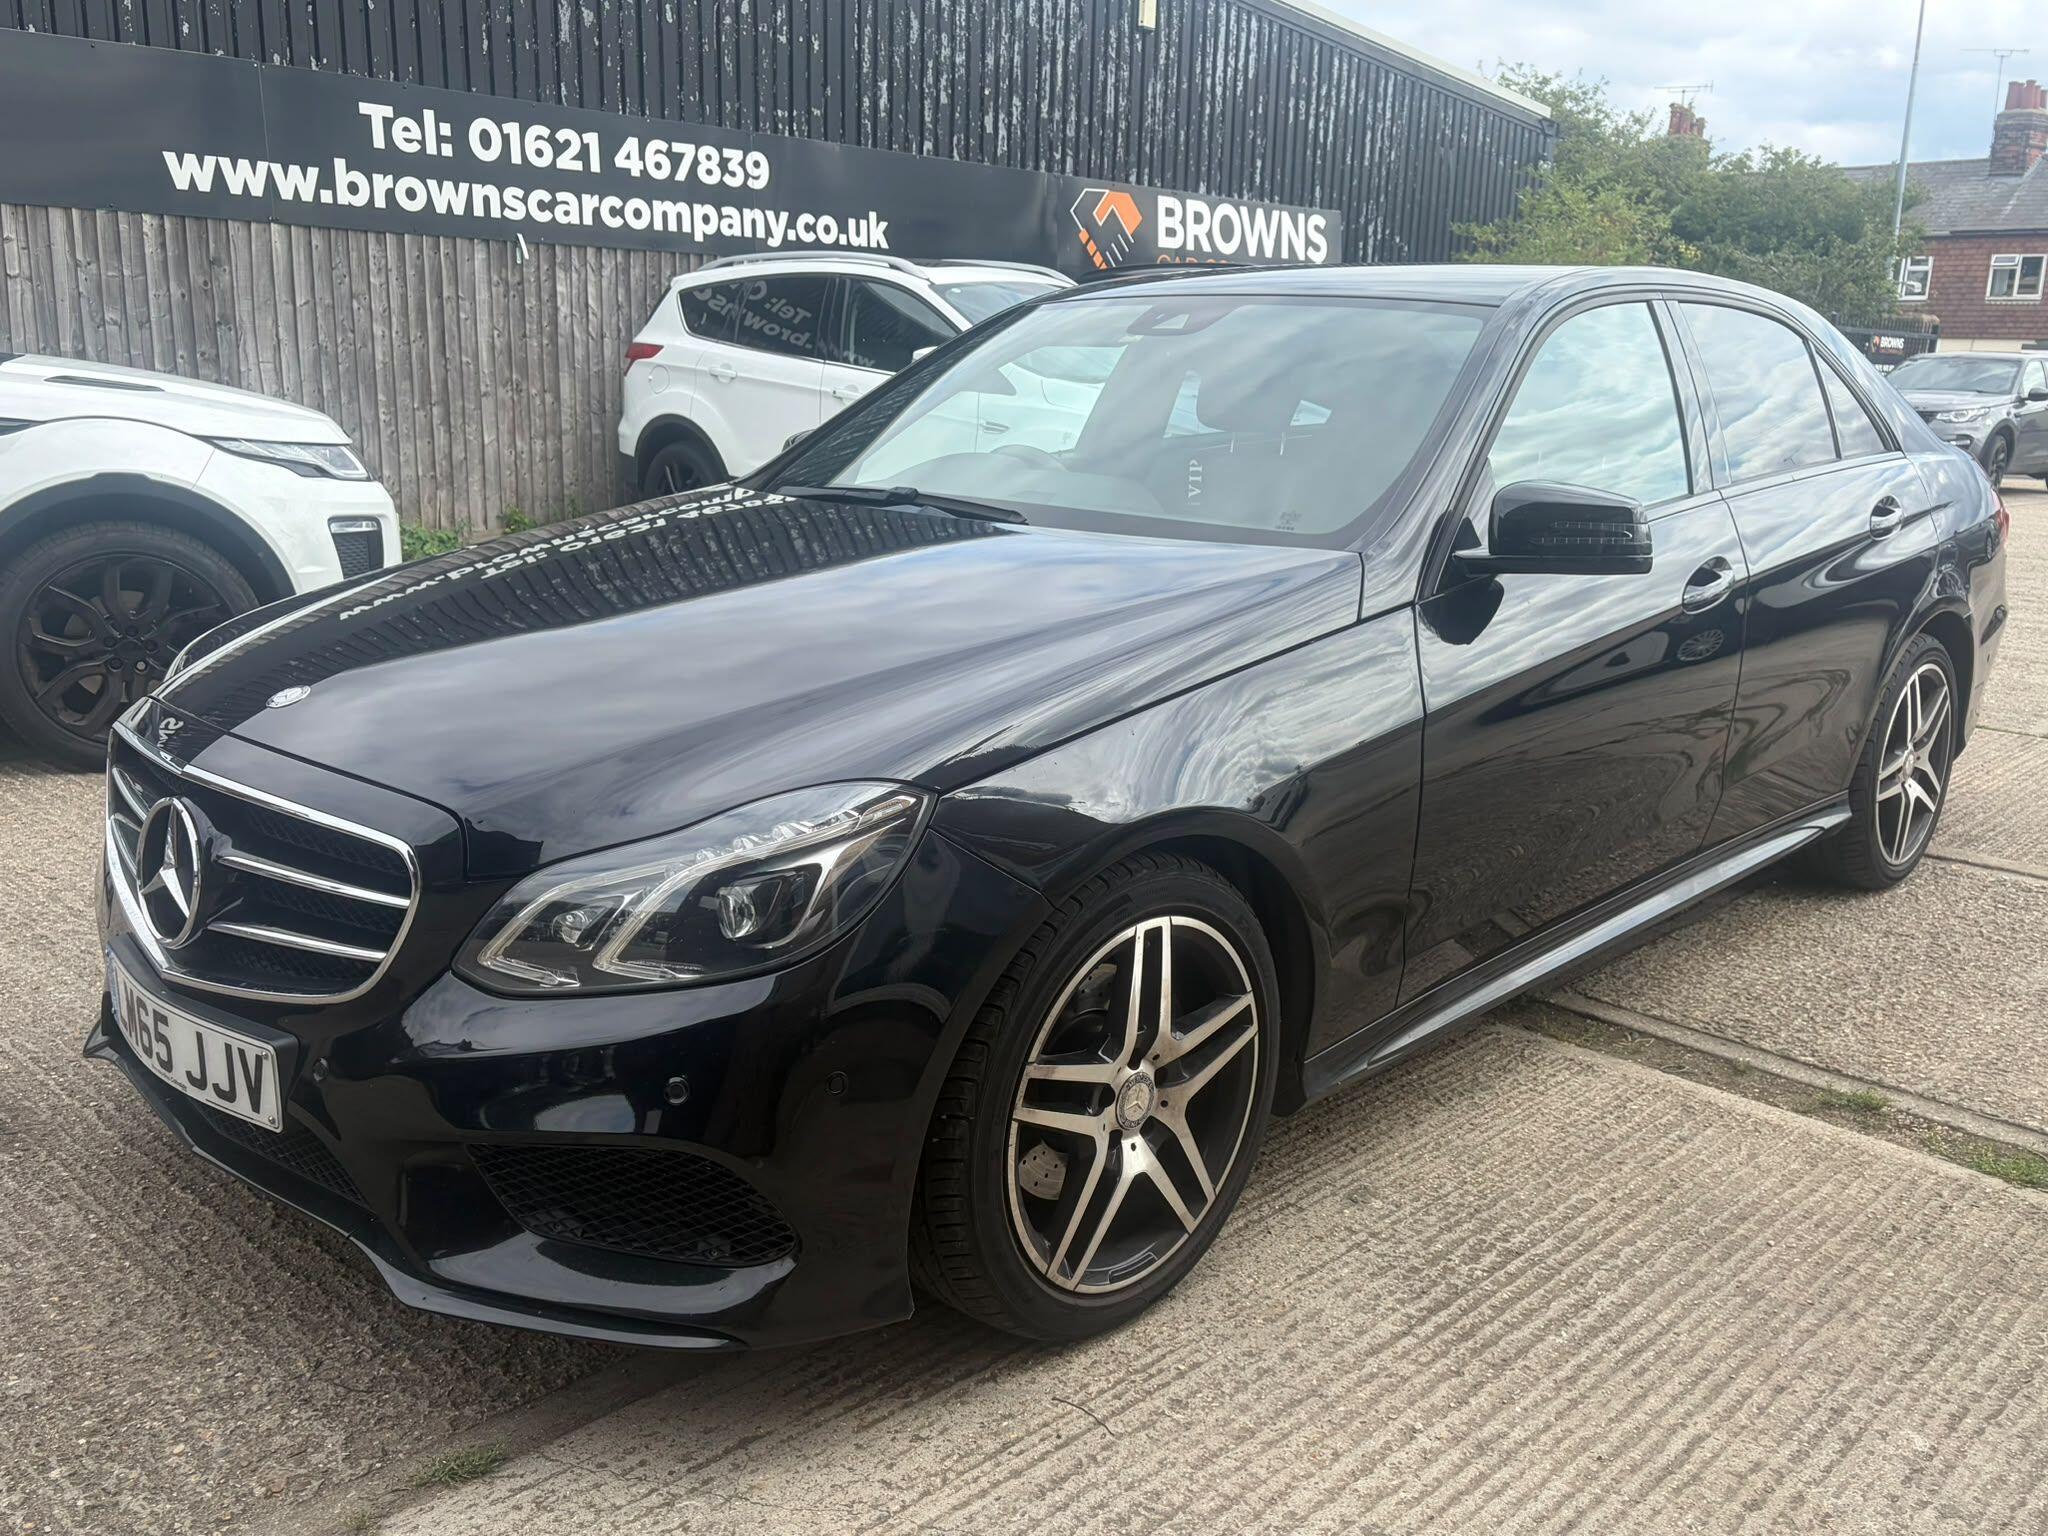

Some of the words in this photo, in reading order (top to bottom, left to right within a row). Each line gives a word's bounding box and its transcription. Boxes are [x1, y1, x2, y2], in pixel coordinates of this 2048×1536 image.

[358, 101, 453, 157] Tel:
[468, 117, 601, 173] 01621
[614, 136, 770, 190] 467839
[162, 151, 889, 249] www.brownscarcompany.co.uk
[1157, 195, 1328, 264] BROWNS
[186, 1031, 264, 1114] JJV
